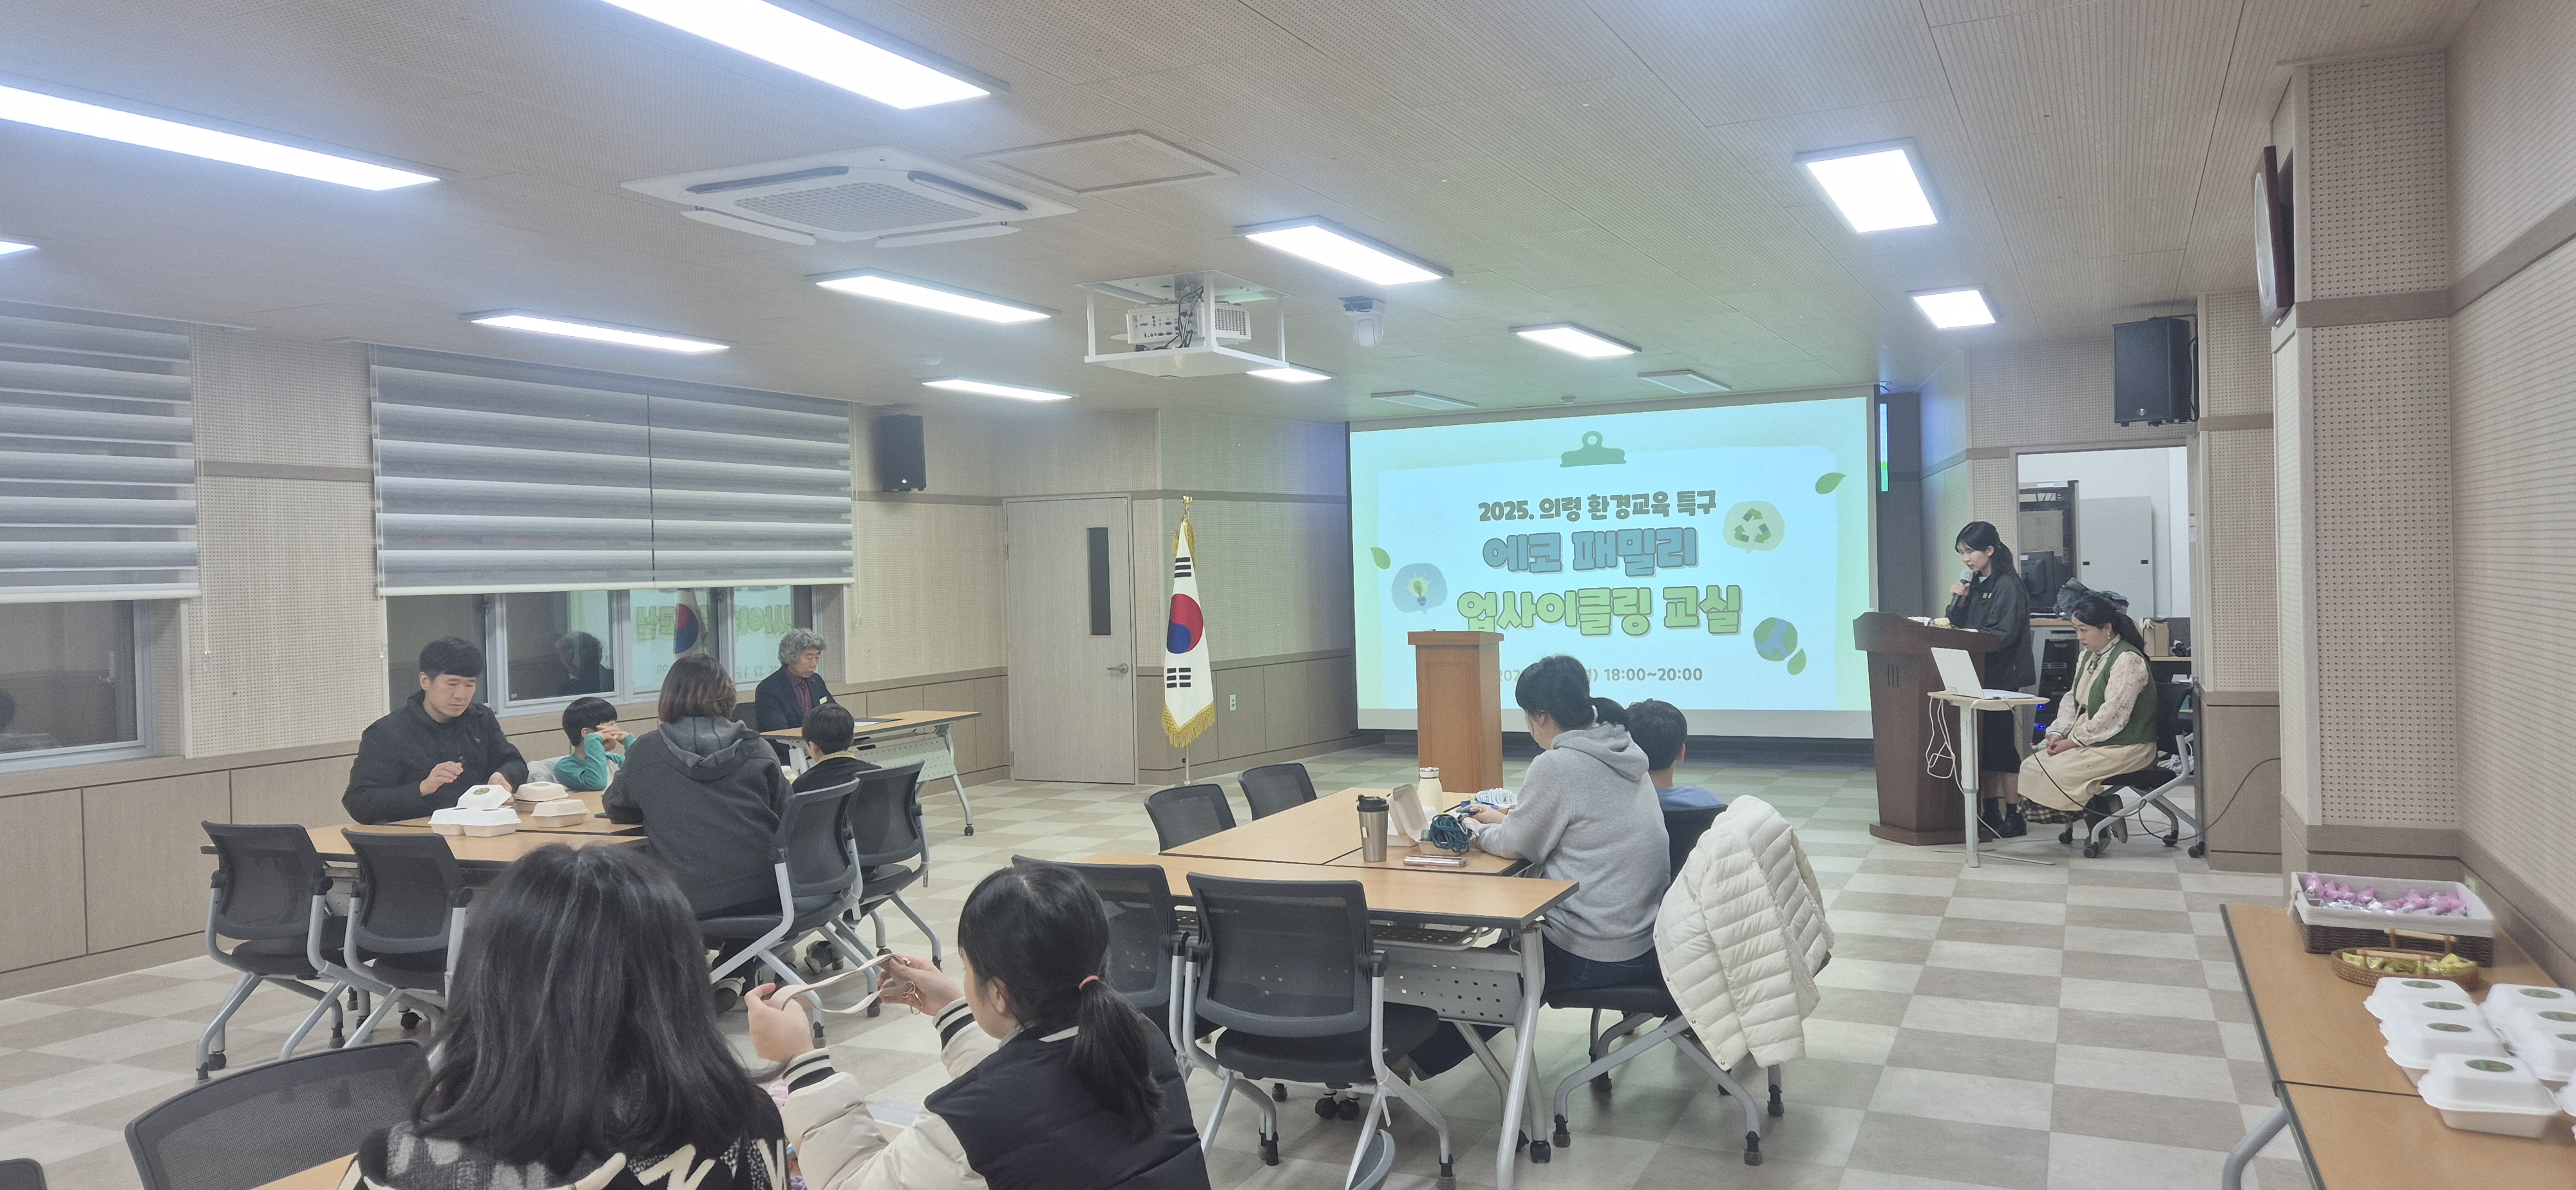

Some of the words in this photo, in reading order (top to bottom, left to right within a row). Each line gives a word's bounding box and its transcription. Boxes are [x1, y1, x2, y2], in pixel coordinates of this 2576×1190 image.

[1478, 500, 1535, 522] 2025.
[1539, 496, 1582, 522] 의령
[1587, 491, 1671, 520] 환경교육
[1676, 490, 1717, 516] 특구
[1482, 532, 1563, 574] 에코
[1571, 527, 1698, 578] 패밀리
[1457, 587, 1653, 637] 업사이클링
[1662, 584, 1741, 634] 교실
[1603, 667, 1703, 681] 18:00~20:00
